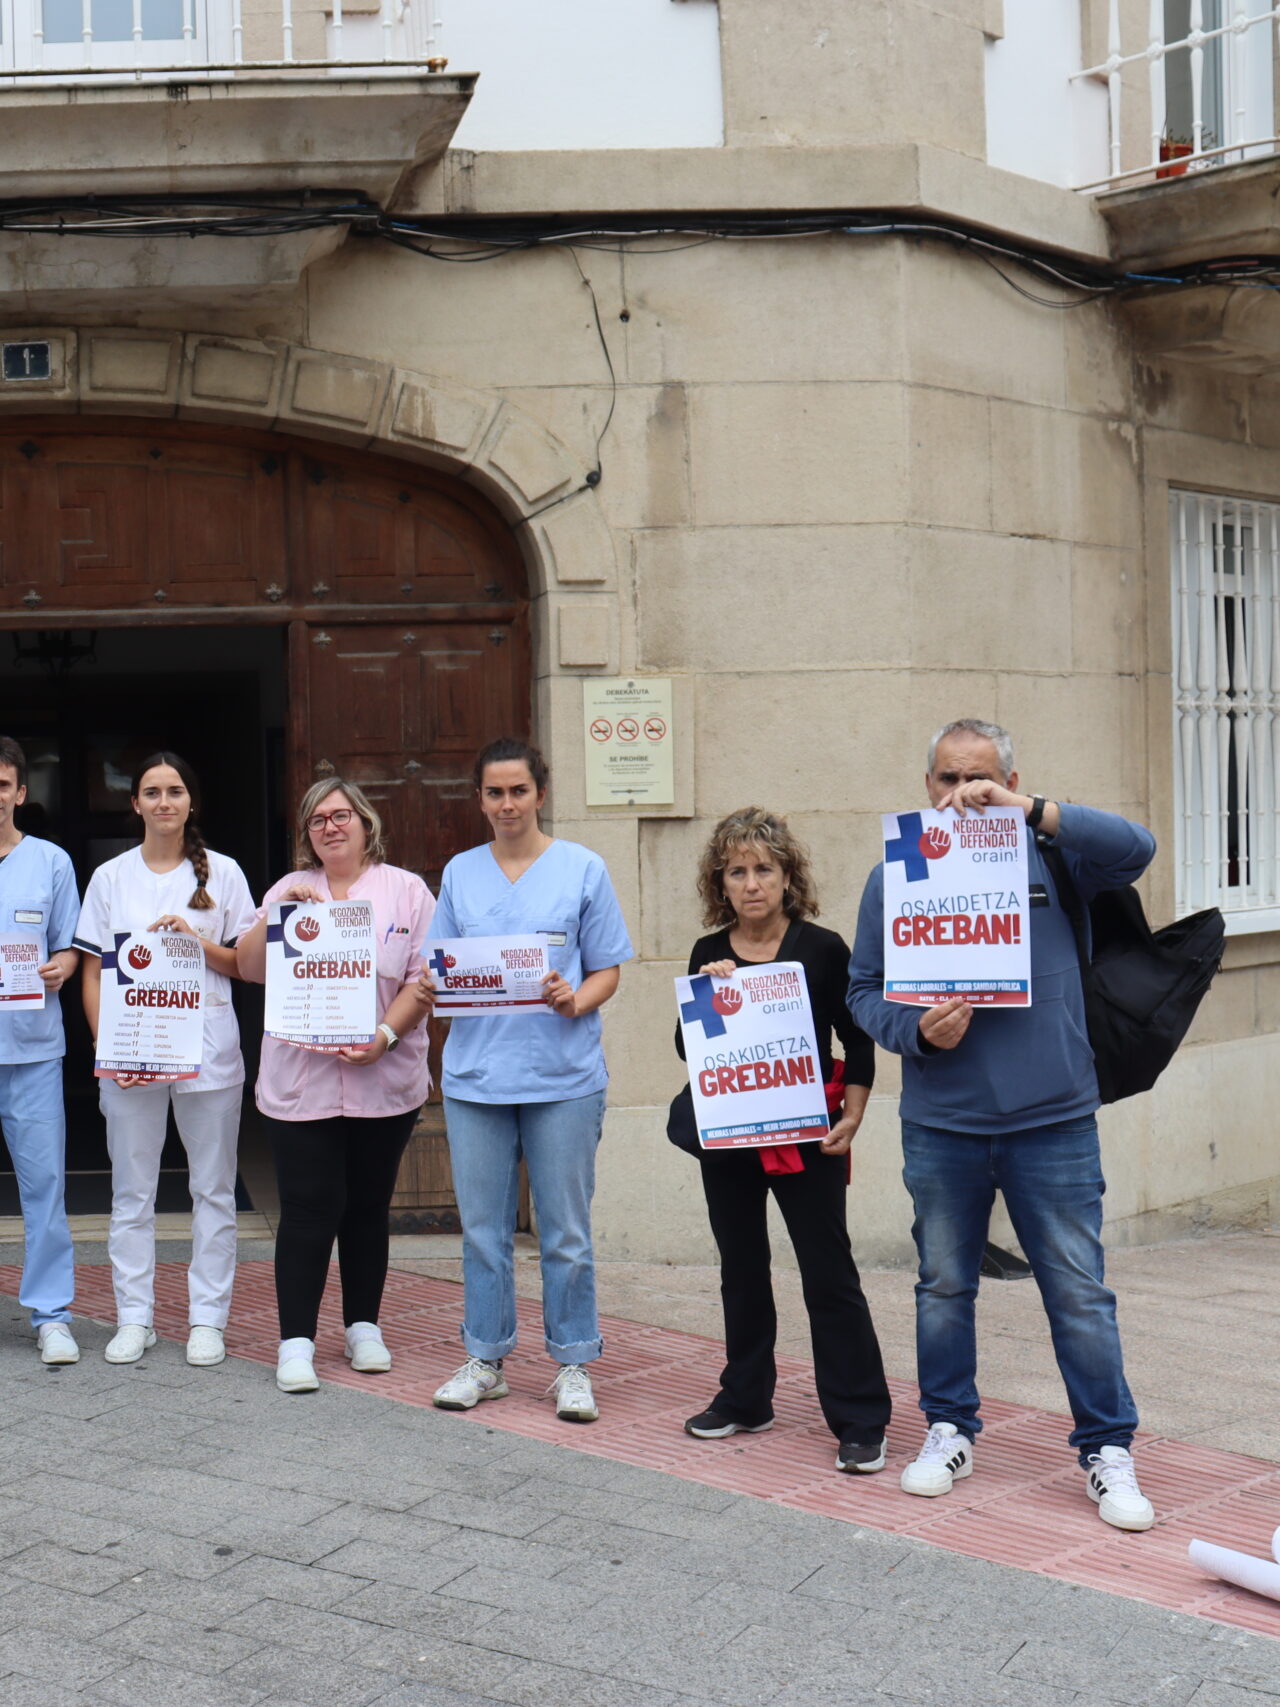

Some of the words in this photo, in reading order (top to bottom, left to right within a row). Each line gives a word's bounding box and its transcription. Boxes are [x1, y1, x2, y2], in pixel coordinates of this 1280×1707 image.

[952, 818, 1018, 834] NEGOZIAZIOA
[960, 834, 1018, 848] DEFENDATU
[972, 849, 1018, 863] orain!
[901, 891, 1020, 919] OSAKIDETZA
[329, 906, 370, 918] NEGOZIAZIOA
[334, 916, 370, 928] DEFENDATU
[341, 928, 372, 938] orain!
[892, 914, 1021, 946] GREBAN!
[0, 944, 38, 954] NEGOZIAZIOA
[166, 948, 200, 959] DEFENDATU
[306, 949, 371, 962] OSAKIDETZA
[500, 948, 542, 960] NEGOZIAZIOA
[4, 952, 38, 962] DEFENDATU
[172, 959, 201, 970] orain!
[293, 960, 371, 979] GREBAN!
[506, 958, 544, 970] DEFENDATU
[450, 966, 502, 977] OSAKIDETZA
[514, 968, 544, 978] orain!
[138, 980, 200, 992] OSAKIDETZA
[444, 974, 503, 989] GREBAN!
[741, 971, 800, 992] NEGOZIAZIOA
[124, 988, 200, 1010] GREBAN!
[750, 984, 801, 1003] DEFENDATU
[762, 998, 804, 1015] orain!
[704, 1035, 811, 1071] OSAKIDETZA
[698, 1055, 816, 1098] GREBAN!
